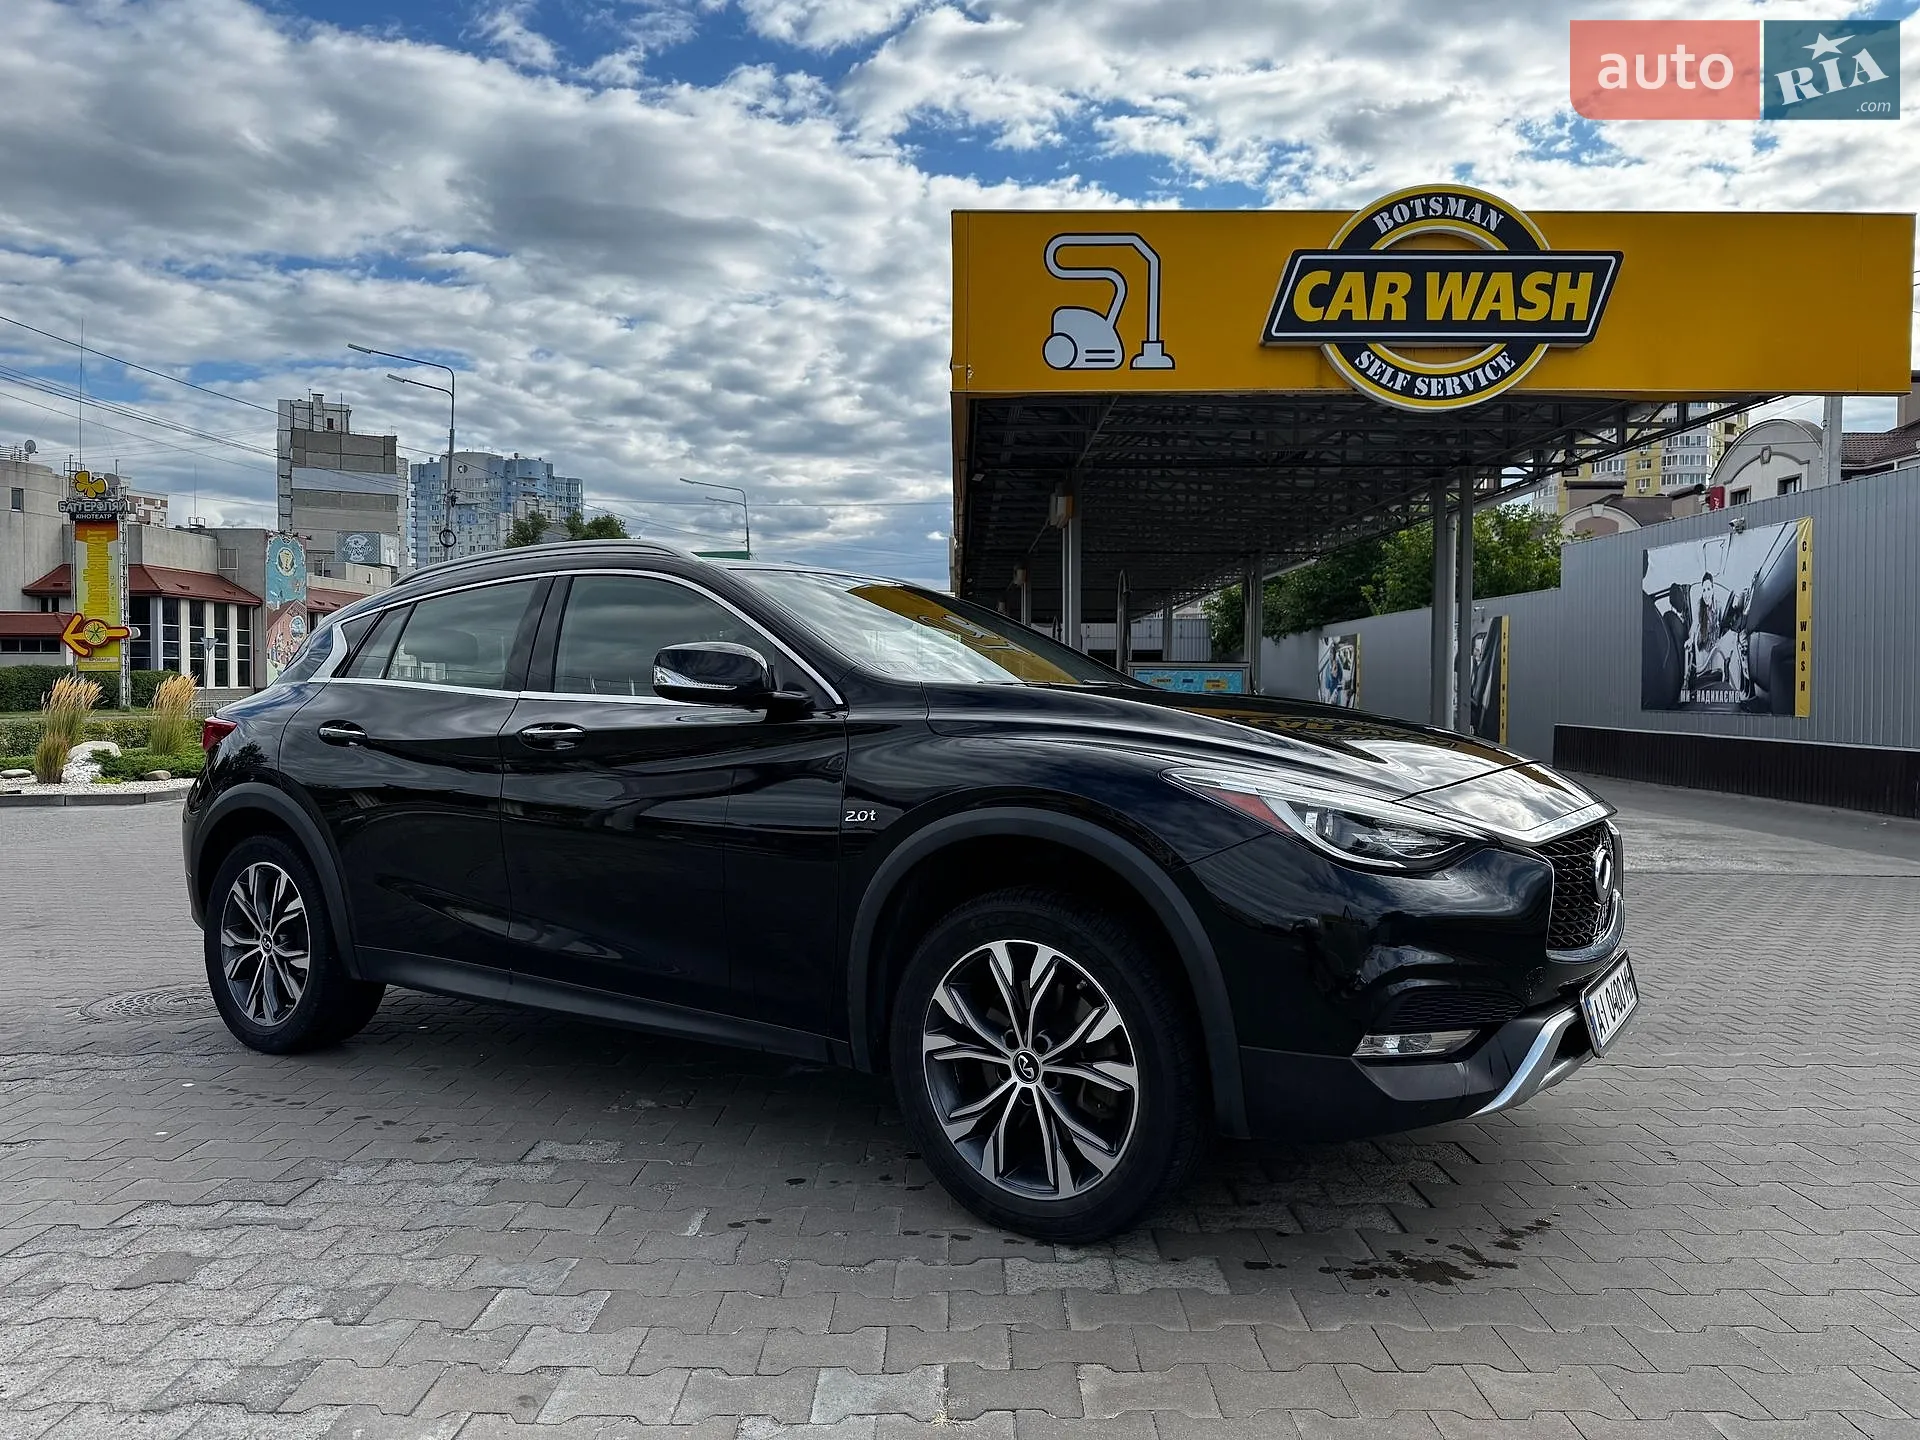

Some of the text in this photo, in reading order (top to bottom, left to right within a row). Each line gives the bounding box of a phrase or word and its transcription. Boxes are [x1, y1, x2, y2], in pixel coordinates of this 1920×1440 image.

[1372, 196, 1505, 234] BOTSMAN
[1293, 270, 1594, 322] CAR WASH
[1354, 350, 1516, 398] SELF SERVICE
[58, 500, 128, 512] БАТТЕРФЛЯЙ
[845, 810, 876, 821] 2.0t
